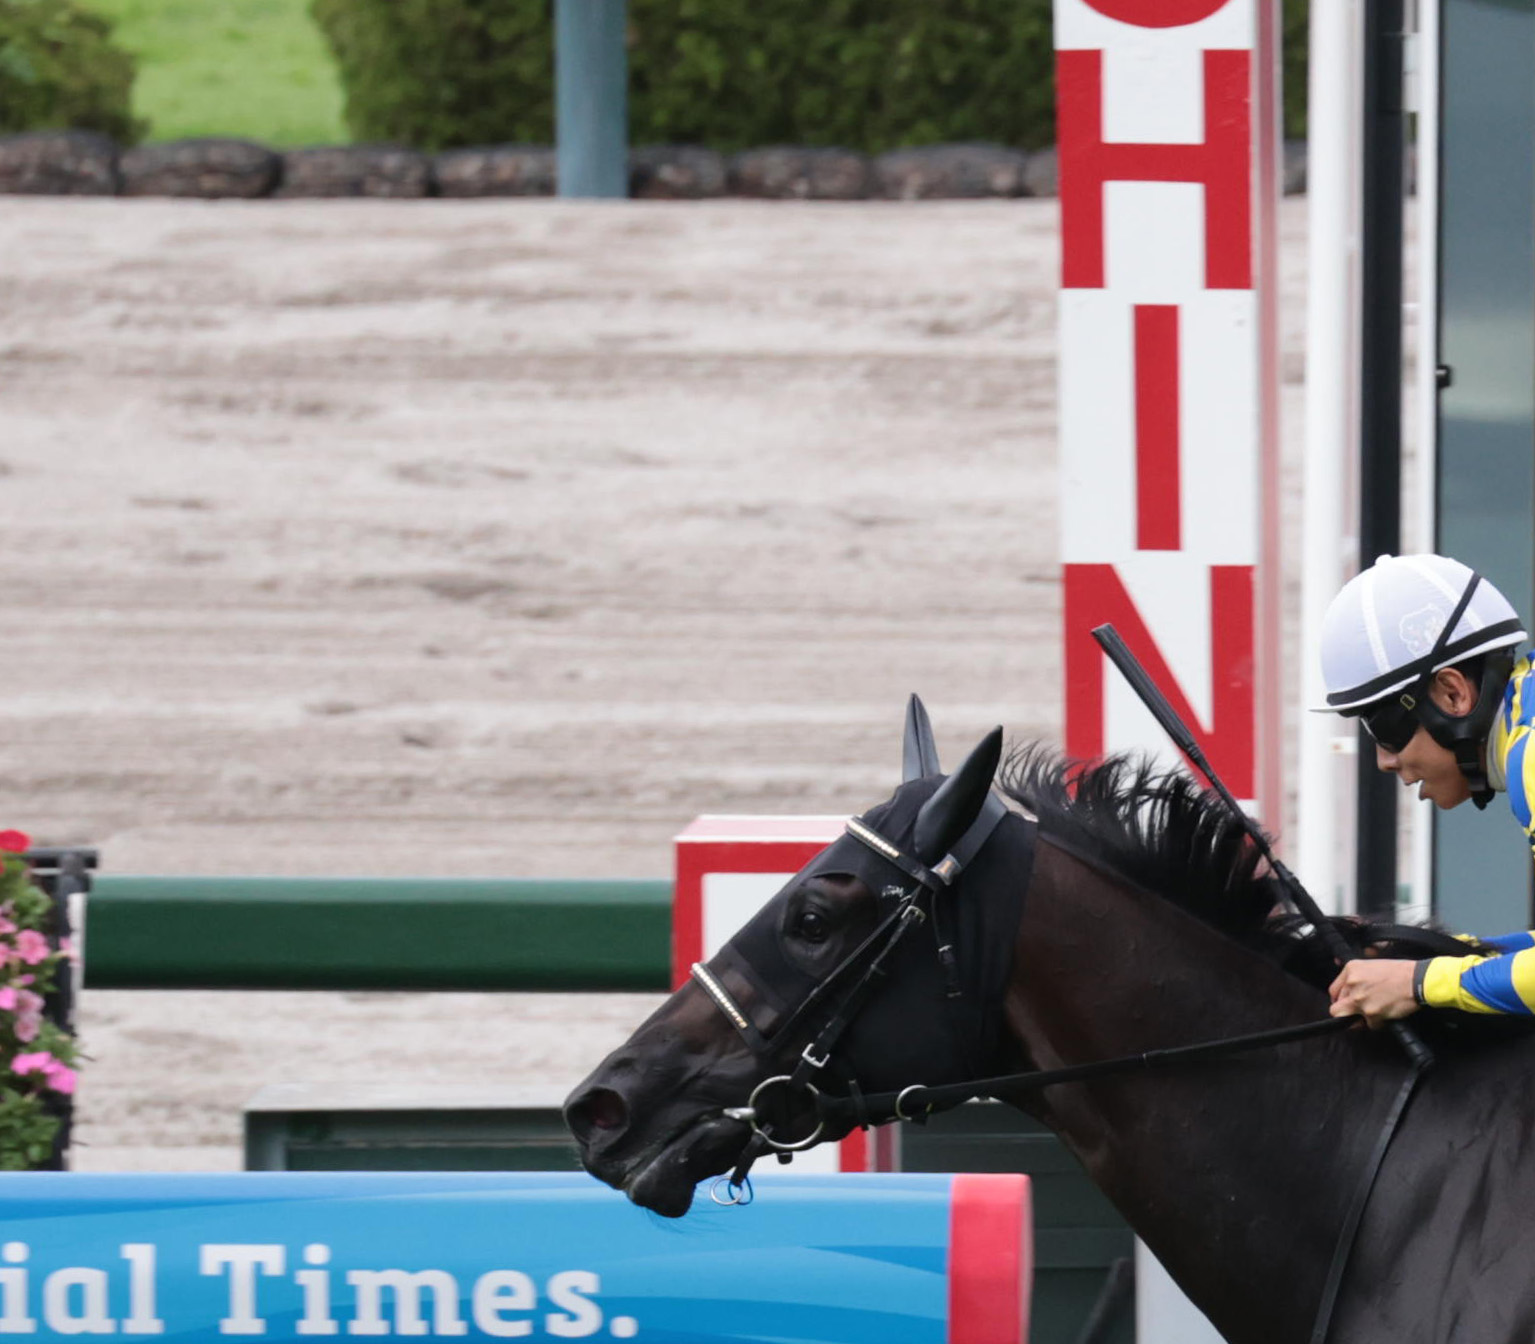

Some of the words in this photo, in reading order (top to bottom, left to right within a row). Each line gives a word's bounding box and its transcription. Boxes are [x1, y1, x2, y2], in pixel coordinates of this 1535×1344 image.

[1055, 0, 1256, 802] HIN
[0, 1241, 164, 1336] ial
[200, 1243, 638, 1339] Times.
